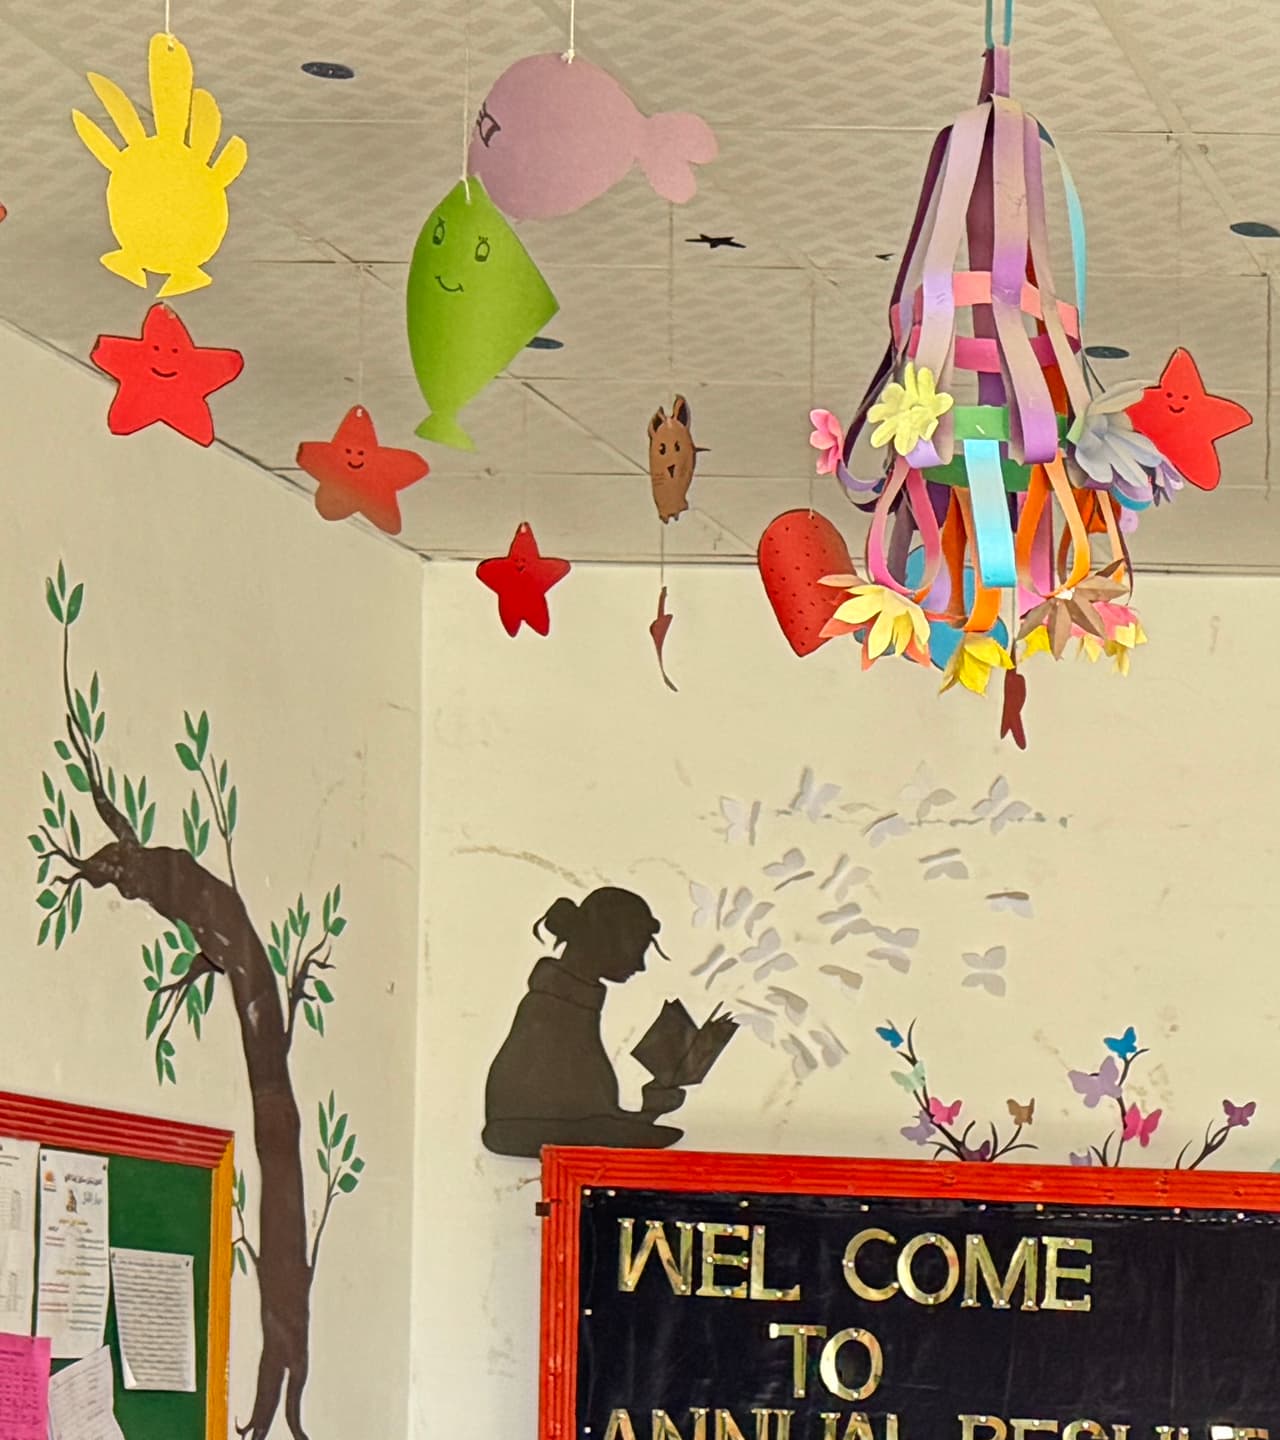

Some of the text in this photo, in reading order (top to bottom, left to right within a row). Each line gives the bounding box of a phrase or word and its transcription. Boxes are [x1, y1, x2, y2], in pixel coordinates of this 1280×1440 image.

[616, 1216, 1093, 1312] WEL COME
[769, 1322, 884, 1401] TO
